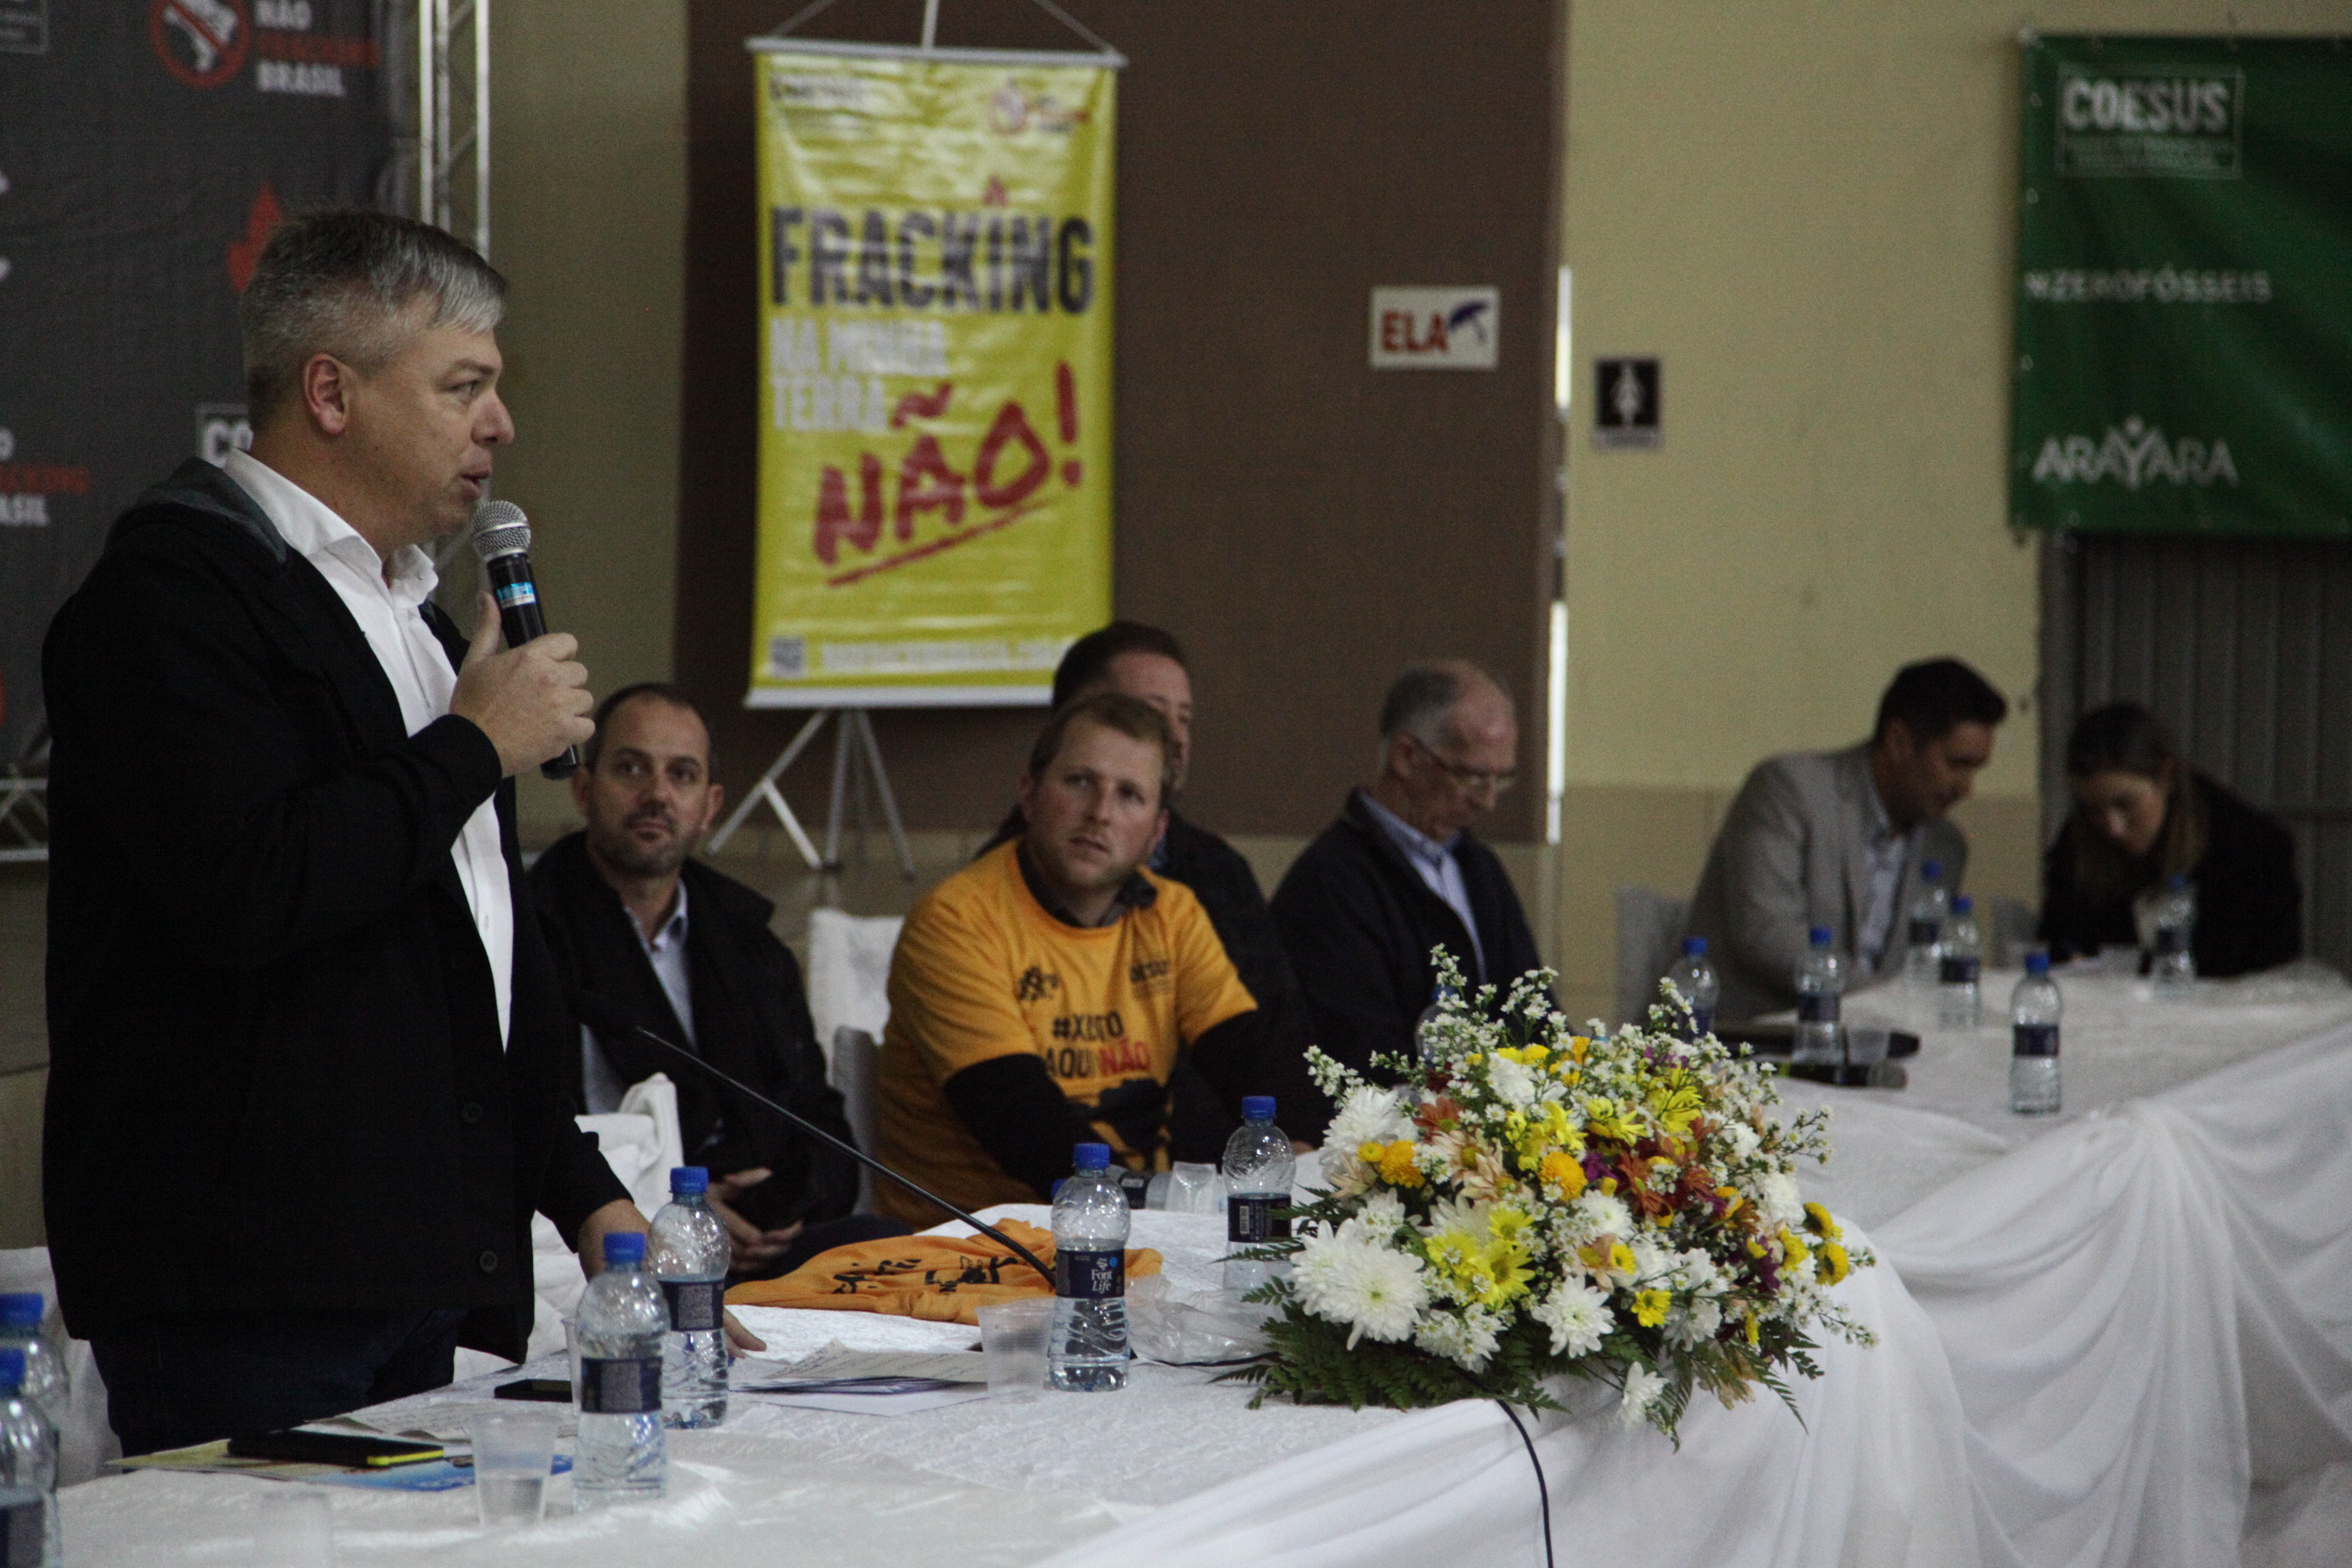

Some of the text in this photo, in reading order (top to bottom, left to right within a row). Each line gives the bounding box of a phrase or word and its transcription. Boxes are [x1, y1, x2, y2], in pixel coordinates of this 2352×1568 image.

[2062, 77, 2231, 133] COESUS
[770, 205, 1094, 314] FRACKING
[813, 360, 1084, 566] NÃO!
[1098, 1037, 1151, 1078] NÃO
[1092, 1269, 1113, 1280] Font
[1092, 1280, 1111, 1293] Life
